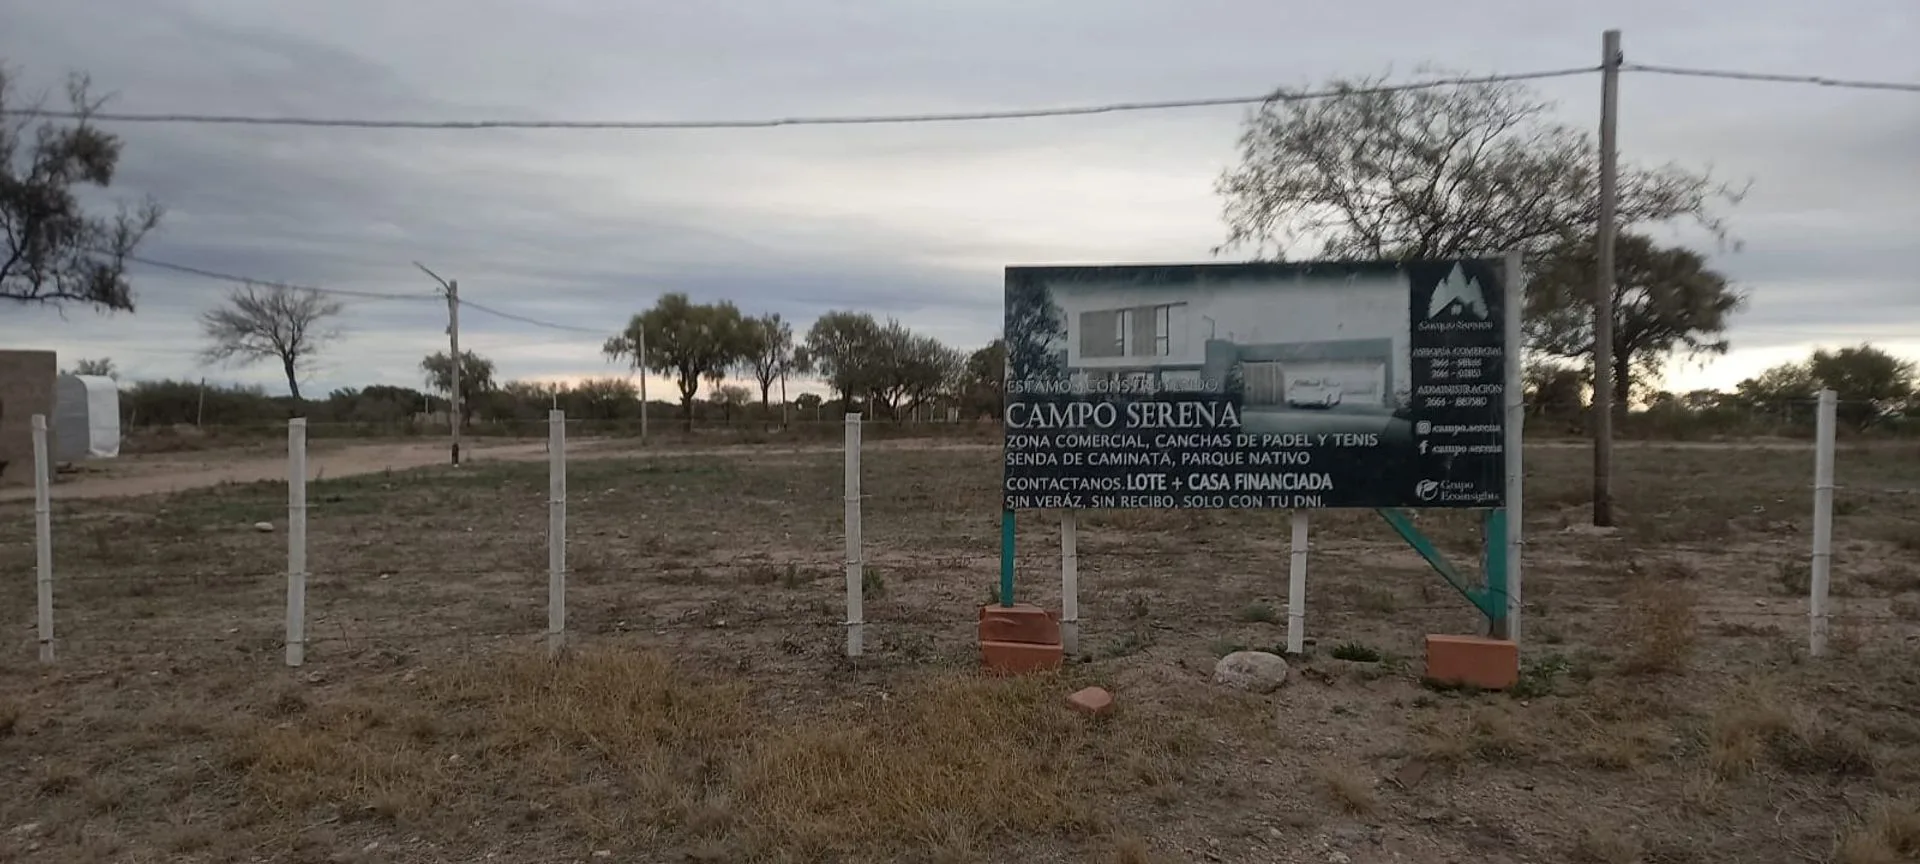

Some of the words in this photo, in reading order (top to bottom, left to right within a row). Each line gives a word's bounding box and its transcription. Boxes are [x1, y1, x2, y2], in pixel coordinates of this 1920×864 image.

[1006, 402, 1117, 428] CAMPO
[1126, 401, 1241, 428] SERENA
[1006, 434, 1051, 449] ZONA
[1056, 434, 1150, 450] COMERCIAL,
[1155, 434, 1231, 448] CANCHAS
[1236, 434, 1258, 448] DE
[1263, 433, 1313, 448] PADEL
[1318, 433, 1329, 447] Y
[1333, 433, 1379, 447] TENIS
[1006, 452, 1057, 467] SENDA
[1062, 452, 1083, 466] DE
[1088, 452, 1176, 468] CAMINATA,
[1181, 452, 1244, 467] PARQUE
[1249, 452, 1310, 466] NATIVO
[1127, 473, 1167, 491] LOTE
[1171, 478, 1183, 491] +
[1188, 473, 1231, 491] CASA
[1234, 473, 1333, 491] FINANCIADA
[1440, 480, 1474, 492] Grupo
[1006, 495, 1030, 509] SIN
[1091, 495, 1115, 508] SIN
[1120, 495, 1179, 509] RECIBO,
[1183, 495, 1224, 508] SOLO
[1229, 495, 1263, 508] CON
[1268, 495, 1289, 508] TU
[1294, 495, 1327, 508] DNI.
